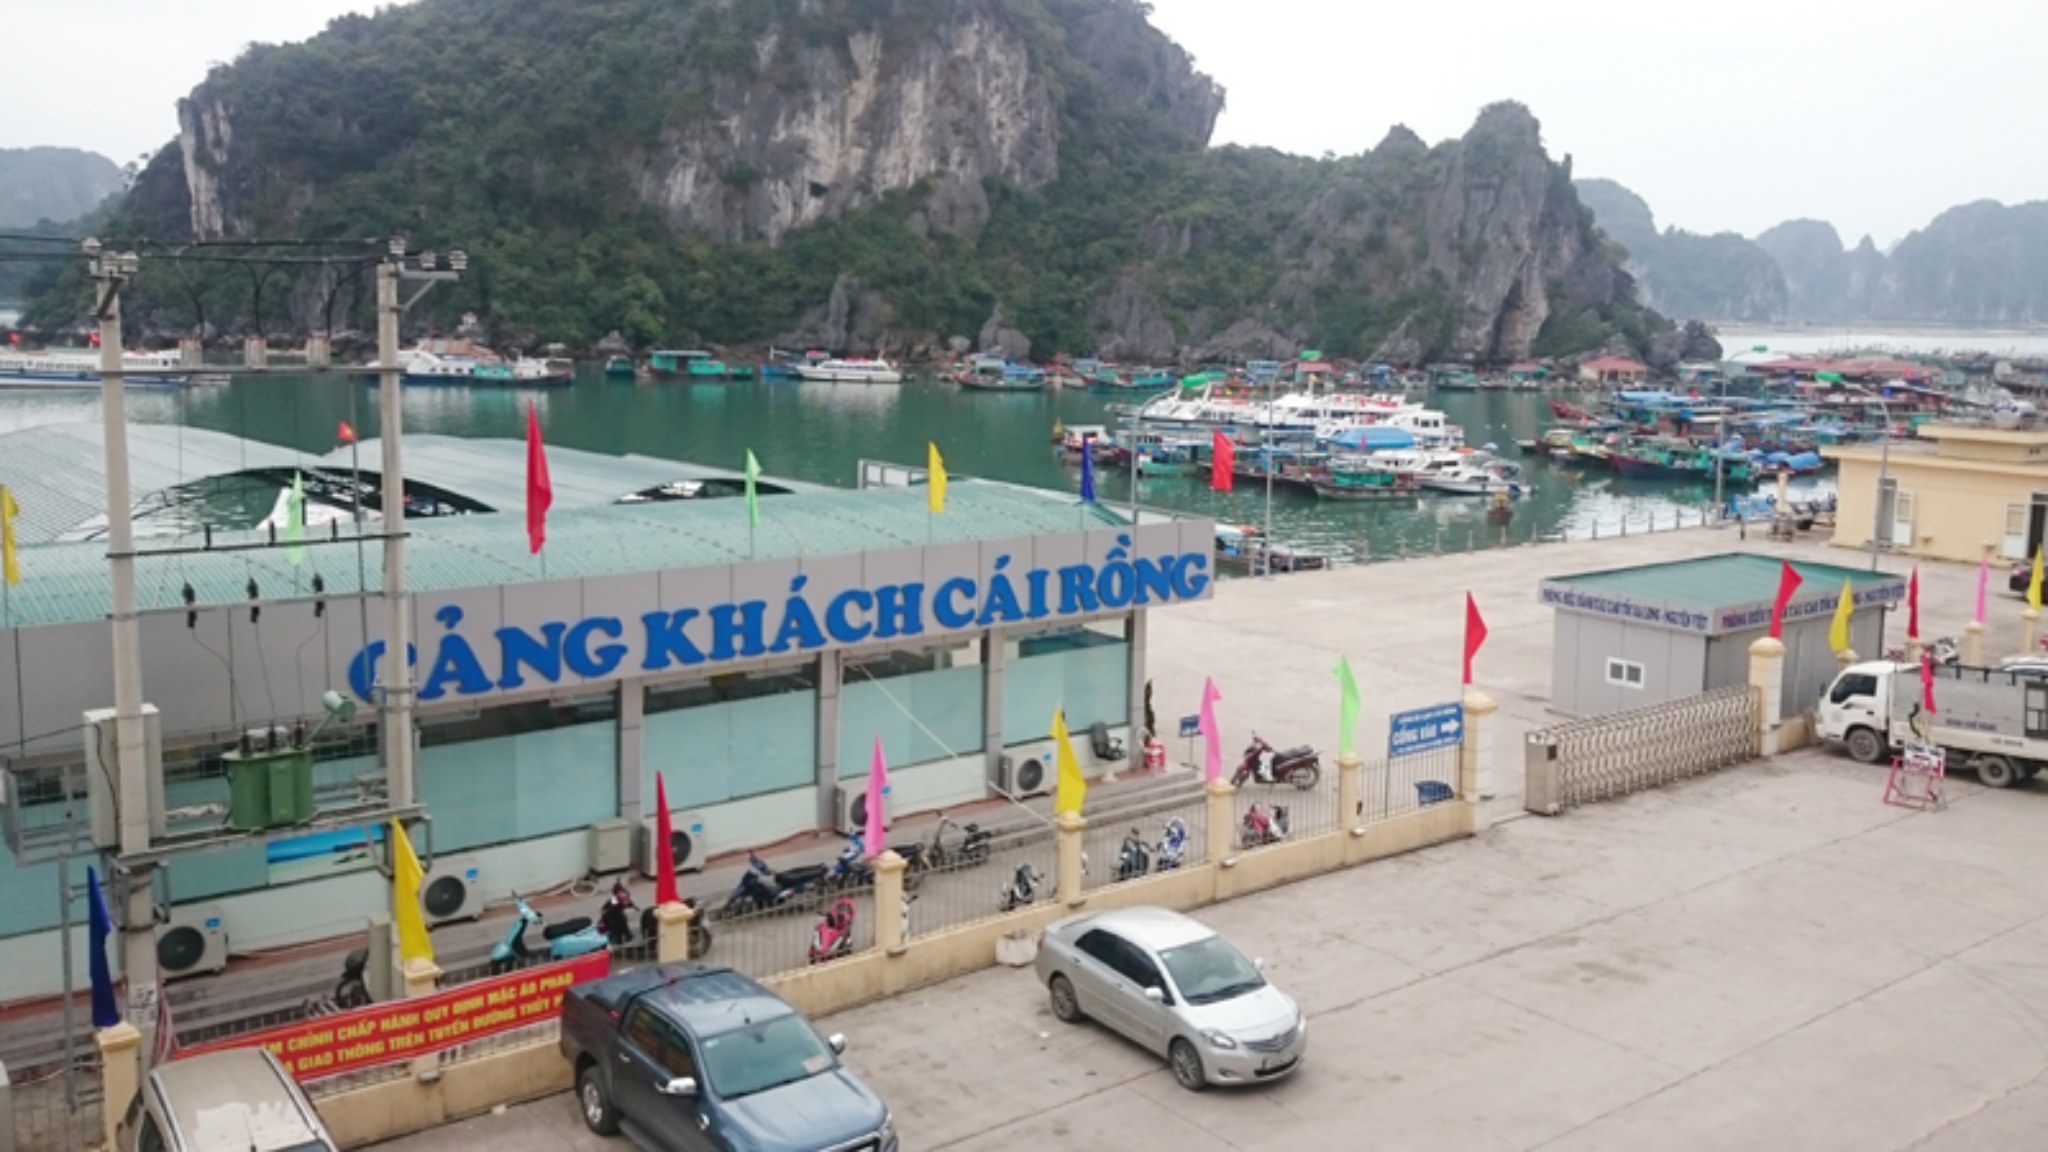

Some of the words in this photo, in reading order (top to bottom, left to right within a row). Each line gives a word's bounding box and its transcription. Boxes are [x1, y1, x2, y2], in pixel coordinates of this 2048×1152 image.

[349, 605, 628, 704] CẢNG
[641, 574, 925, 670] KHÁCH
[933, 554, 1050, 629] CÁI
[1057, 533, 1210, 615] RỒNG
[381, 1012, 420, 1032] HÀNH
[424, 1005, 449, 1023] QUY
[519, 979, 537, 997] ÁO
[540, 972, 574, 992] PHAO
[298, 1051, 333, 1072] GIAO
[337, 1040, 384, 1062] THÔNG
[389, 1029, 425, 1050] TRÊN
[428, 1018, 469, 1042] TUYẾN
